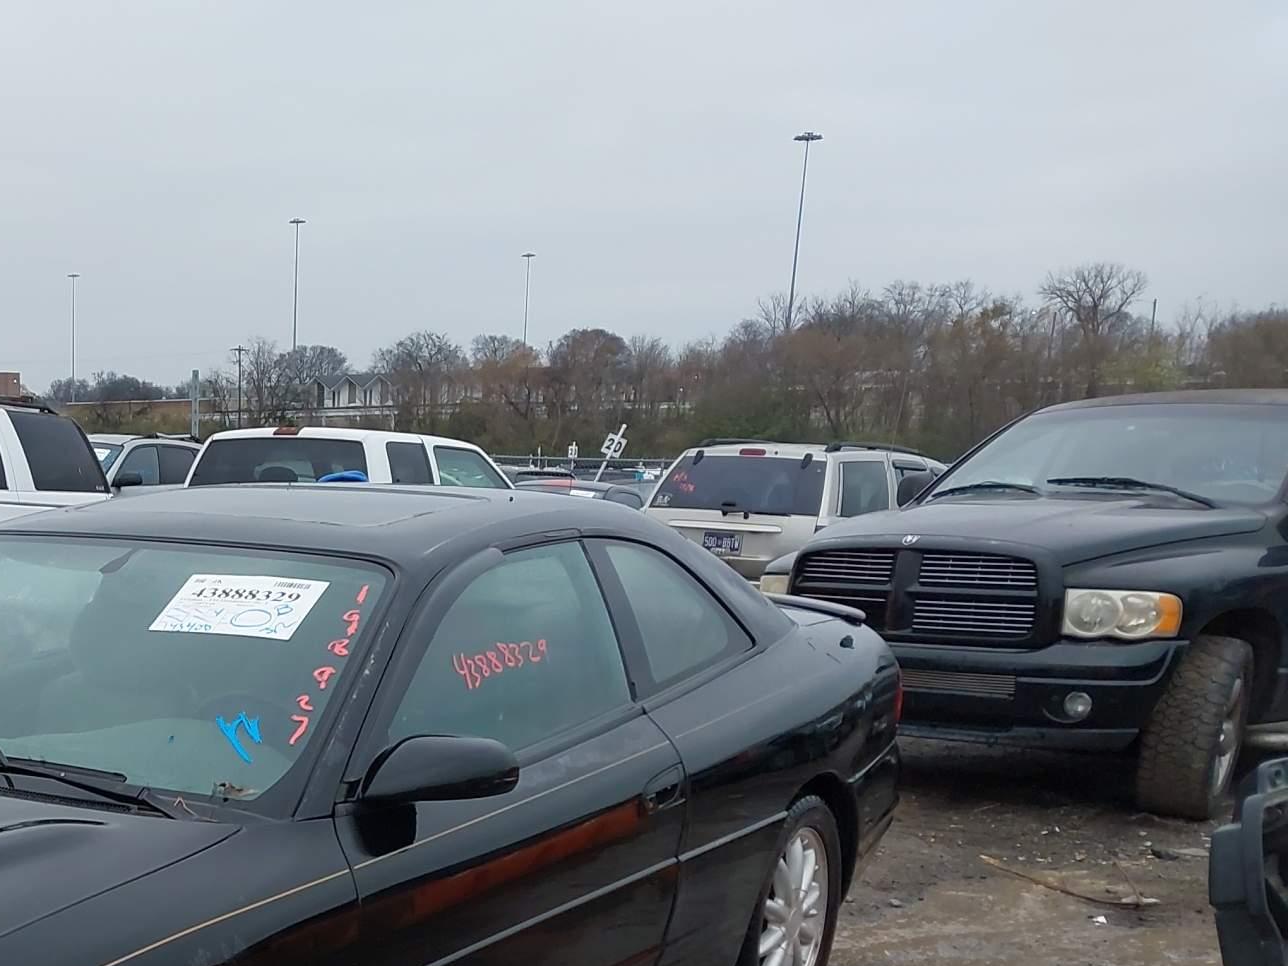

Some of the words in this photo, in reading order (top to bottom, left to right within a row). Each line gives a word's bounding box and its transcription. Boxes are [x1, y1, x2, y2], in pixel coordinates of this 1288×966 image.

[605, 438, 622, 453] 20
[191, 586, 302, 603] 43888329
[453, 639, 547, 689] 43888329
